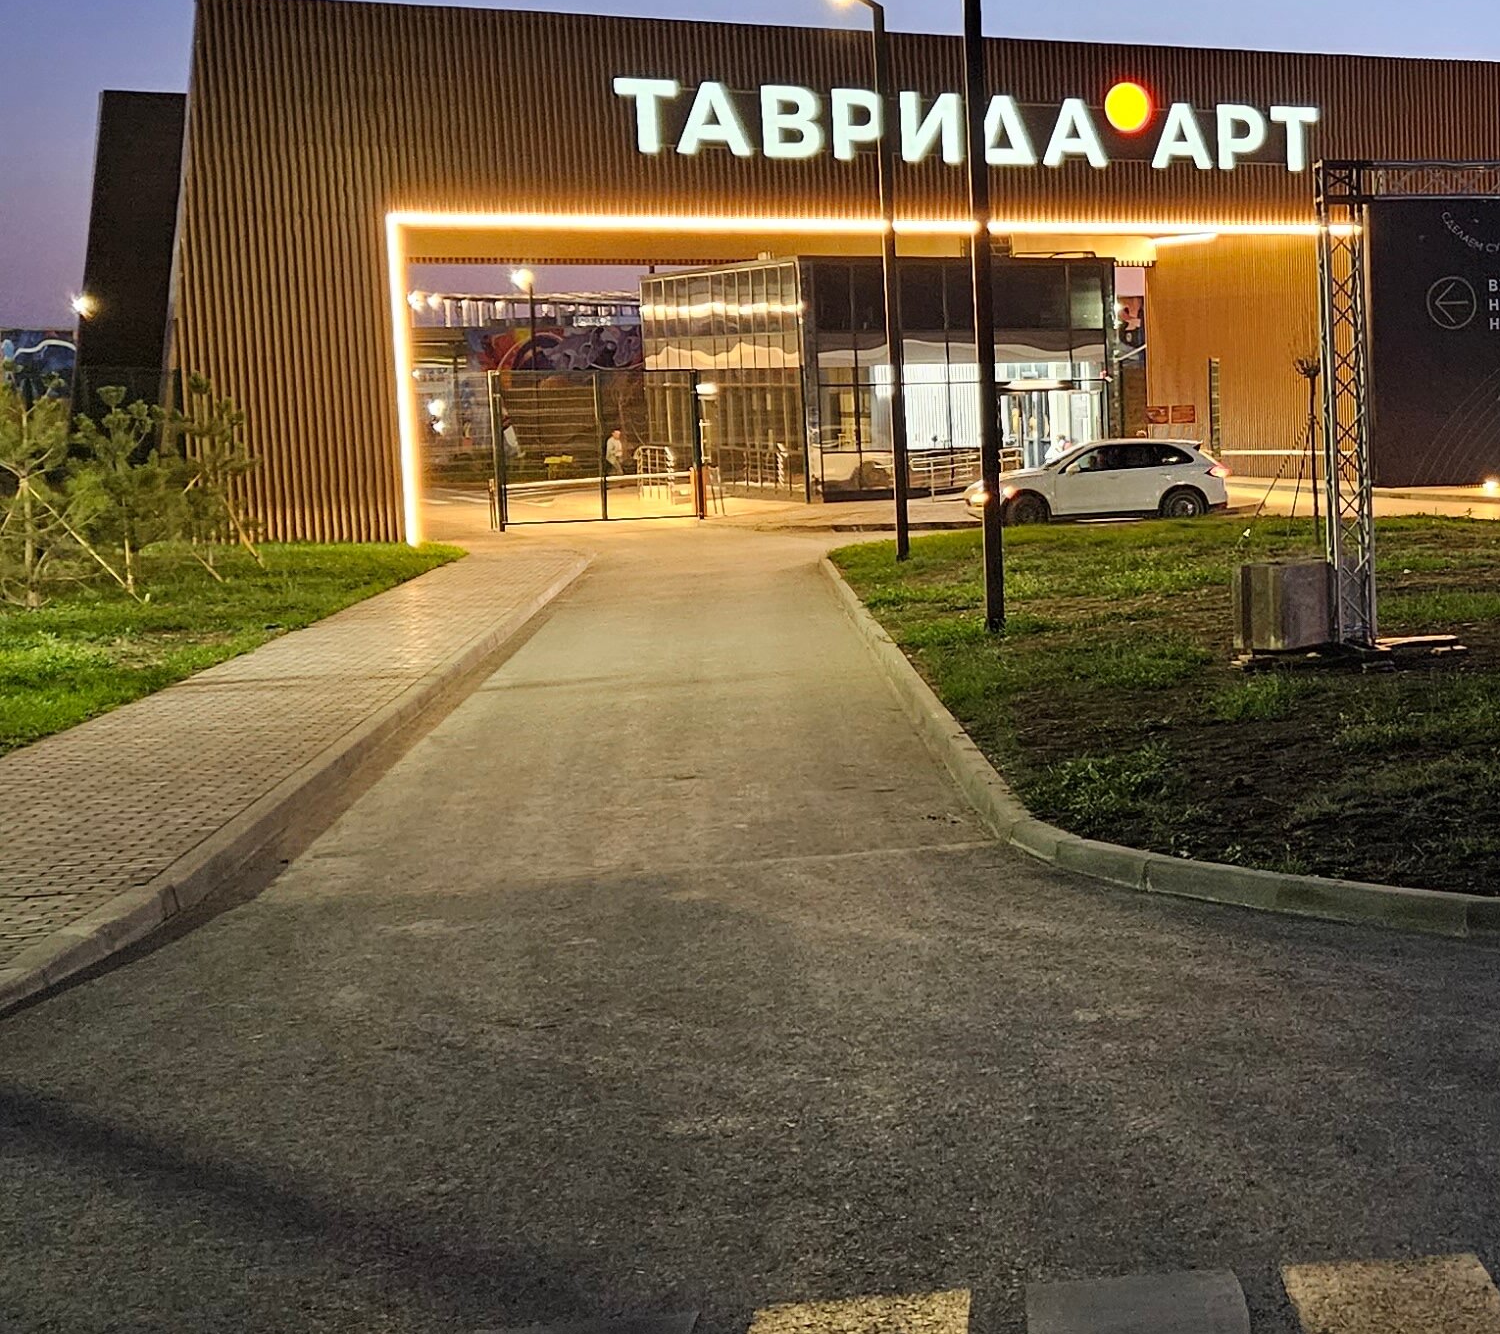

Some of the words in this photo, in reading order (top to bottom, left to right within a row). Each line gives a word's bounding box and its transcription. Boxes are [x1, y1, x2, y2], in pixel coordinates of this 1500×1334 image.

[613, 77, 1109, 168] ТАВРИДА
[1152, 103, 1320, 171] АРТ
[1441, 211, 1483, 252] СДЕЛАЕМ
